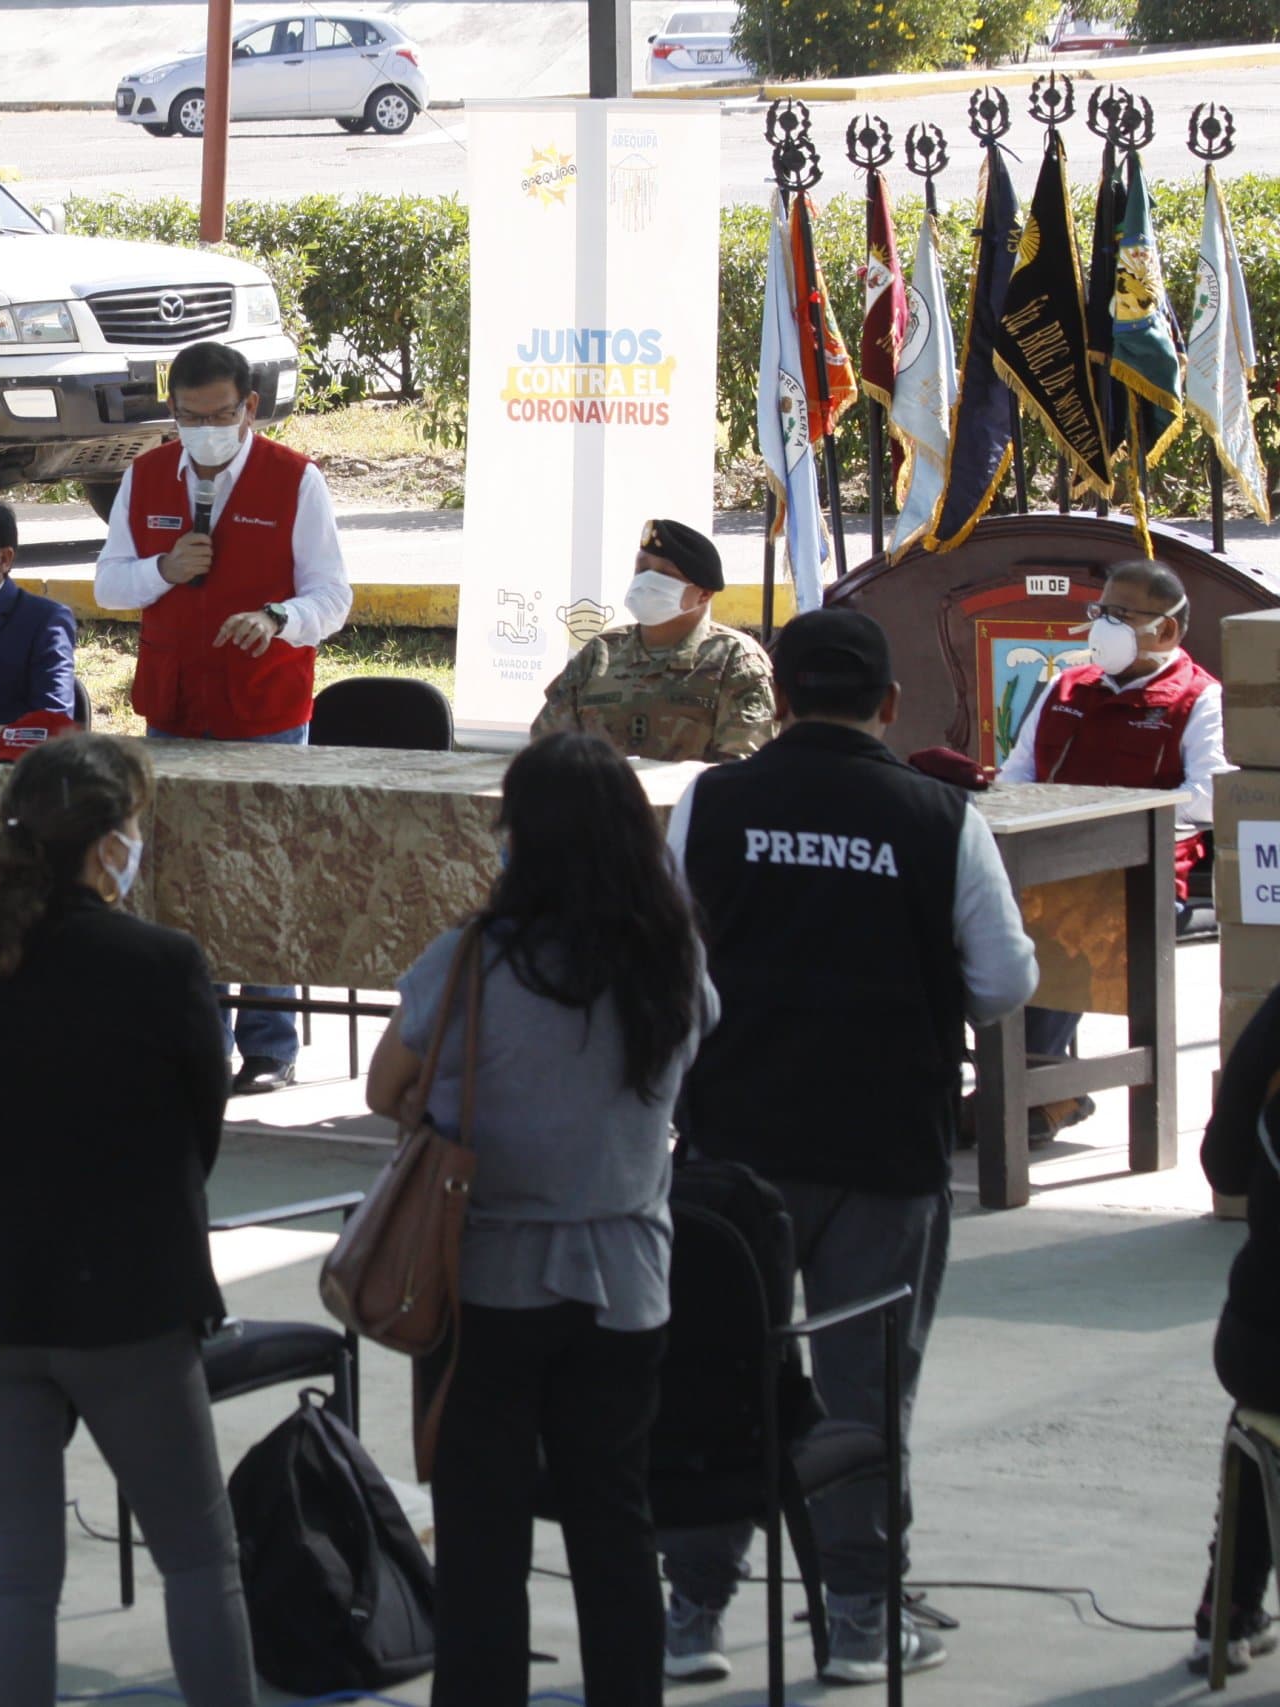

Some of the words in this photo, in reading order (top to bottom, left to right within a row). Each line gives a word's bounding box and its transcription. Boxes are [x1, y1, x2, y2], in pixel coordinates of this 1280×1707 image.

[612, 135, 658, 149] AREQUIPA
[521, 164, 578, 192] arequipa
[517, 328, 663, 365] JUNTOS
[515, 367, 628, 395] CONTRA
[633, 368, 666, 396] EL
[1040, 364, 1075, 396] DE
[507, 398, 670, 426] CORONAVIRUS
[1030, 580, 1043, 591] III
[1049, 579, 1066, 592] DE
[493, 658, 529, 670] LAVADO
[530, 660, 542, 670] DE
[500, 671, 534, 681] MANOS
[744, 828, 899, 878] PRENSA
[1255, 845, 1280, 868] M
